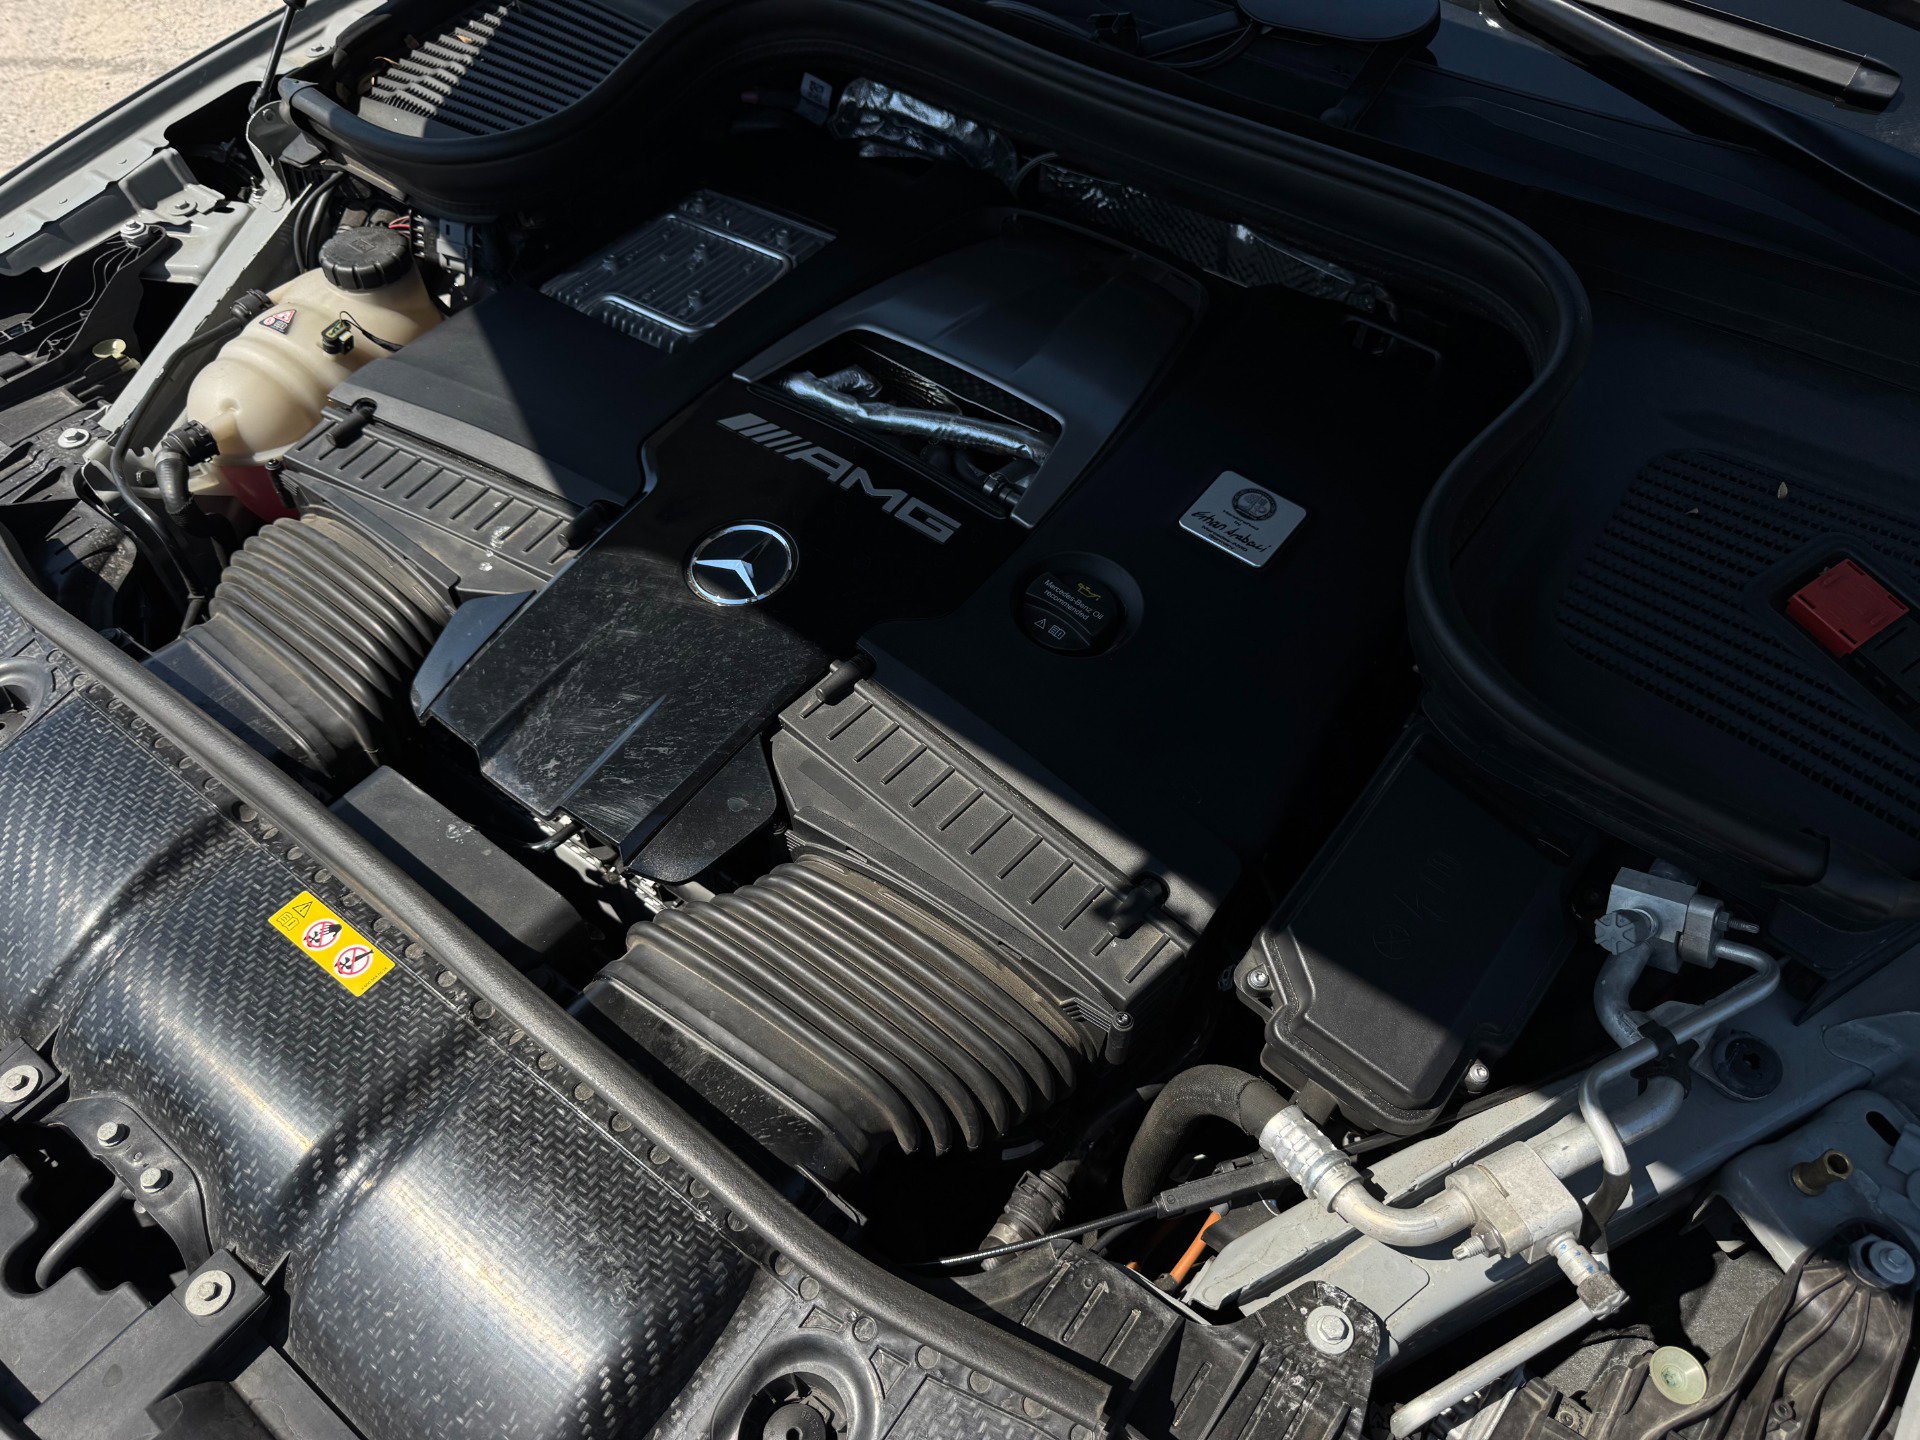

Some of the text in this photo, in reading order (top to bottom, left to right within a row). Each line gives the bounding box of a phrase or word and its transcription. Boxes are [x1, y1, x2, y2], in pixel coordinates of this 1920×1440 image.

[785, 446, 962, 544] AMG
[1044, 579, 1105, 620] Mercedes-Benz Oil
[1044, 589, 1090, 620] recommended
